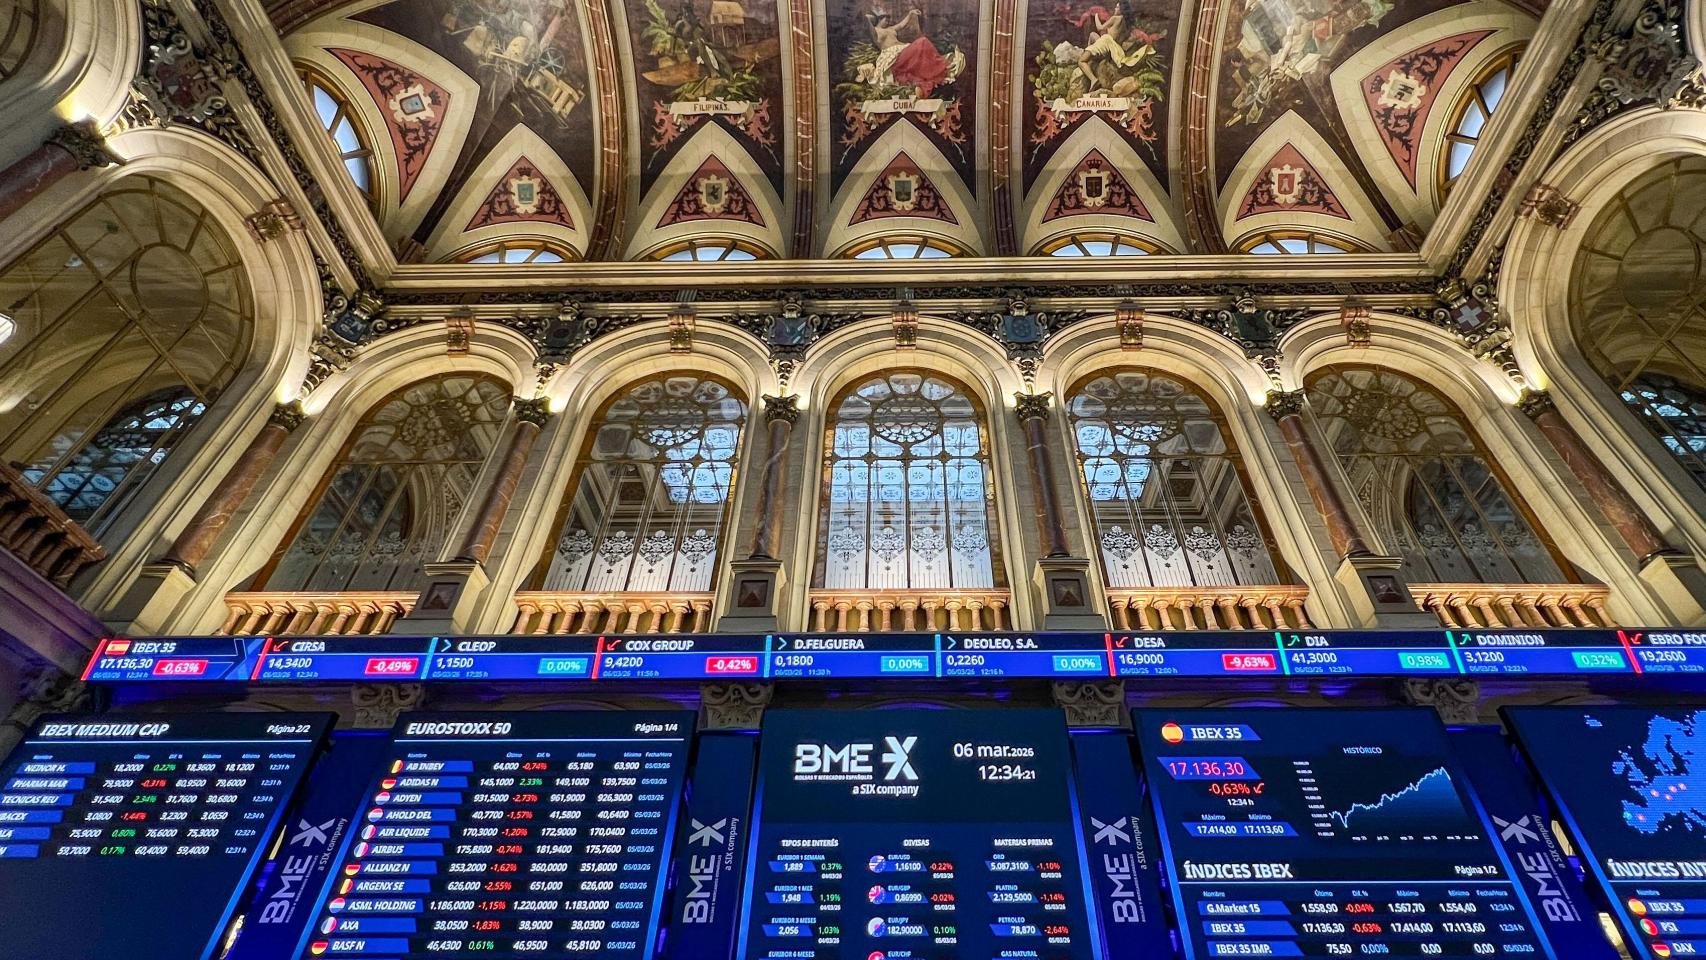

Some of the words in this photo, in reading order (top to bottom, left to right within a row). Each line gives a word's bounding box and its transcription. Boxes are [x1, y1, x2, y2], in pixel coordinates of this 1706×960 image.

[794, 639, 865, 649] D.FELGUERA
[964, 638, 1014, 649] DEOLEO,
[1016, 638, 1038, 649] S.A.
[1134, 638, 1165, 648] DESA
[1305, 636, 1329, 647] DIA
[1476, 635, 1545, 646] DOMINION
[1648, 634, 1683, 645] EBRO
[132, 642, 160, 654] IBEX
[160, 642, 176, 653] 35
[292, 642, 326, 652] CIRSA
[458, 642, 497, 652] CLEOP
[626, 640, 650, 651] COX
[652, 640, 694, 651] GROUP
[946, 655, 984, 666] 0,2260
[1060, 658, 1095, 669] 0,00%
[1119, 654, 1164, 665] 16,9000
[1230, 657, 1270, 668] -9,63%
[1291, 652, 1337, 664] 41,3000
[1407, 655, 1443, 666] 0,98%
[1464, 652, 1504, 663] 3,1200
[1581, 654, 1618, 666] 0,32%
[1639, 652, 1687, 662] 19,2600
[100, 658, 154, 669] 17.136,30
[161, 662, 199, 674] -0,63%
[268, 658, 312, 669] 14,3400
[373, 661, 412, 672] -0,49%
[436, 658, 474, 669] 1,1500
[547, 661, 581, 672] 0,00%
[605, 657, 643, 668] 9,4200
[713, 660, 751, 670] -0,42%
[775, 656, 814, 667] 0,1800
[888, 660, 923, 670] 0,00%
[39, 724, 78, 737] IBEX
[76, 724, 139, 736] MEDIUM
[139, 724, 170, 736] CAP
[266, 725, 295, 734] Página
[296, 725, 311, 733] 2/2
[407, 723, 492, 735] EUROSTOXX
[494, 723, 512, 735] 50
[635, 724, 663, 734] Página
[665, 724, 678, 732] 1/4
[1191, 728, 1223, 739] IBEX
[1225, 728, 1242, 739] 35
[953, 743, 974, 758] 06
[1343, 746, 1383, 754] HISTÓRICO
[795, 744, 873, 773] BME
[1169, 762, 1244, 777] 17.136,30
[479, 779, 514, 787] 145,1000
[555, 778, 590, 786] 149,1000
[853, 786, 859, 794] a
[860, 784, 875, 794] SIX
[877, 785, 919, 796] company
[1208, 784, 1250, 795] -0,63%
[393, 795, 422, 803] ADYEN
[386, 811, 415, 820] AHOLD
[416, 811, 432, 820] DEL
[378, 828, 399, 837] AIR
[400, 828, 430, 837] LIQUIDE
[728, 818, 739, 851] company
[1131, 816, 1143, 850] company
[1197, 826, 1237, 834] 17.414,00
[1244, 826, 1284, 834] 17.113,60
[1532, 814, 1554, 848] company
[320, 852, 331, 864] SIX
[327, 818, 348, 852] company
[782, 839, 801, 847] TIPOS
[802, 839, 811, 847] DE
[812, 838, 838, 847] INTERÉS
[372, 845, 404, 854] AIRBUS
[725, 852, 733, 864] SIX
[1137, 851, 1146, 864] SIX
[1549, 850, 1562, 862] SIX
[364, 864, 401, 872] ALLIANZ
[401, 864, 410, 872] N
[1184, 860, 1251, 879] ÍNDICES
[1252, 864, 1293, 879] IBEX
[1454, 866, 1483, 876] Página
[1484, 866, 1498, 874] 1/2
[1607, 859, 1679, 877] ÍNDICES
[258, 855, 312, 923] BME
[356, 882, 394, 890] ARGENX
[394, 882, 405, 890] SE
[447, 882, 480, 890] 626,000
[530, 882, 563, 890] 651,000
[581, 882, 614, 890] 626,000
[682, 855, 715, 923] BME
[1104, 854, 1139, 922] BME
[1517, 852, 1575, 921] BME
[348, 901, 373, 910] ASML
[374, 901, 416, 910] HOLDING
[1207, 904, 1248, 913] G.Market
[1249, 904, 1260, 913] 15
[1648, 902, 1672, 911] IBEX
[1672, 902, 1684, 911] 35
[340, 921, 359, 930] AXA
[434, 921, 468, 930] 38,0500
[518, 921, 553, 930] 38,9000
[1044, 926, 1068, 934] -2,64%
[1212, 924, 1233, 933] IBEX
[1234, 924, 1245, 933] 35
[1442, 923, 1485, 933] 17.113,60
[332, 941, 356, 950] BASF
[356, 941, 365, 950] N
[427, 941, 462, 950] 46,4300
[513, 941, 548, 950] 46,9500
[566, 941, 600, 950] 45,8100
[1216, 944, 1238, 953] IBEX
[1239, 944, 1250, 953] 35
[1251, 944, 1272, 953] IMP.
[1326, 944, 1352, 954] 75,50
[1360, 944, 1389, 954] 0,00%
[1421, 944, 1442, 954] 0,00
[1474, 944, 1494, 954] 0,00
[1672, 943, 1696, 953] DAX
